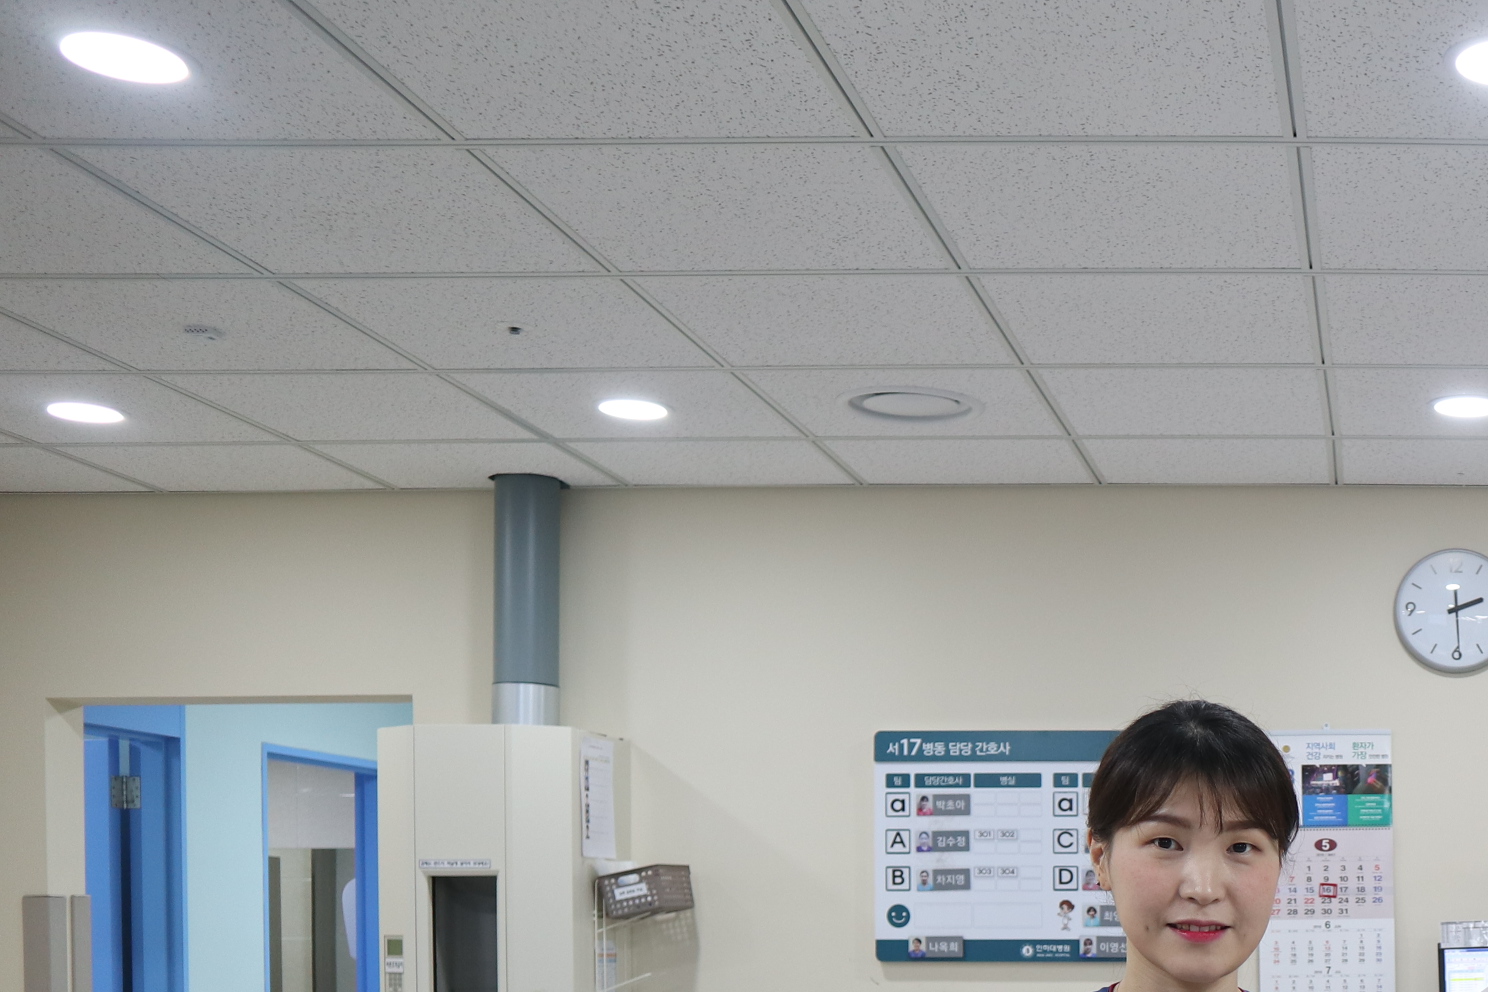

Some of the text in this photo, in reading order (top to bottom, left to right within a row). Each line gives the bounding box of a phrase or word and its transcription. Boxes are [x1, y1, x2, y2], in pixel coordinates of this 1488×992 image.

[1405, 602, 1416, 616] 9
[1452, 646, 1462, 660] 6
[886, 738, 1010, 756] 서17병동 담당 간호사
[1306, 742, 1336, 750] 지역사회
[1352, 742, 1374, 750] 환자가
[1306, 752, 1321, 760] 건강
[1352, 752, 1367, 760] 가장
[894, 776, 902, 786] 팀
[924, 776, 963, 786] 담당간호사
[1000, 776, 1016, 786] 병실
[1061, 776, 1070, 785] 팀
[890, 798, 905, 812] a
[1058, 798, 1073, 811] a
[890, 832, 906, 848] A
[937, 836, 966, 847] 김수정
[1057, 831, 1073, 848] C
[1322, 840, 1330, 850] 5
[892, 869, 905, 885] B
[1059, 868, 1073, 885] D
